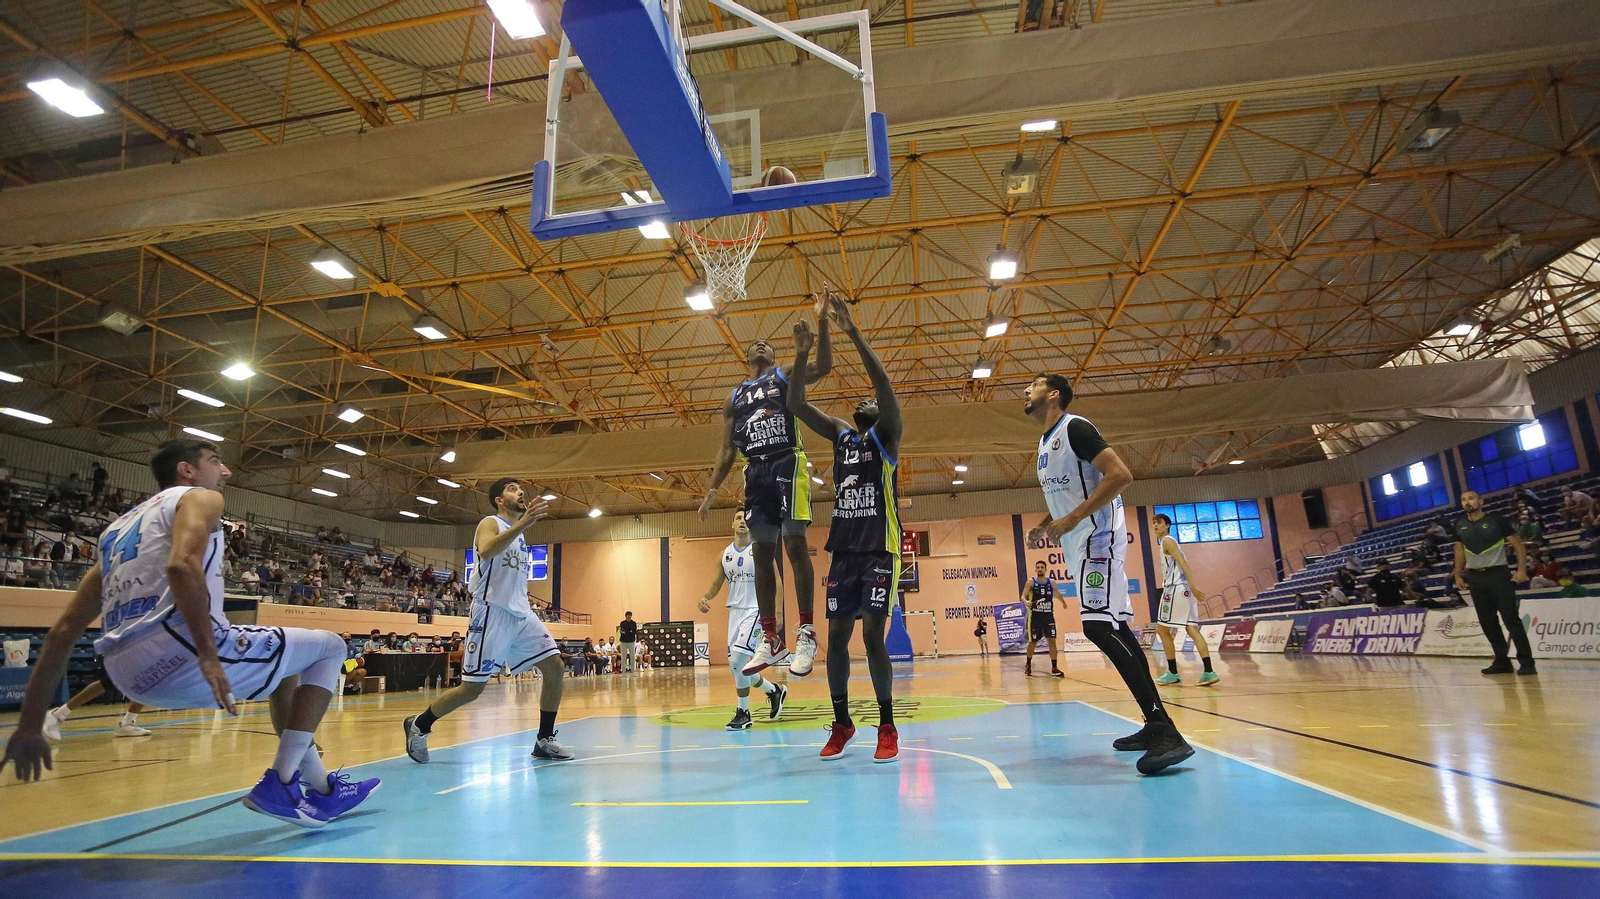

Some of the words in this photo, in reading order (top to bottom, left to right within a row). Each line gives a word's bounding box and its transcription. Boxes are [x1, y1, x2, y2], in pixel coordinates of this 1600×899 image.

[746, 388, 765, 405] 14
[753, 416, 786, 431] ENER
[843, 448, 860, 465] 12
[845, 486, 875, 500] ENER
[100, 514, 142, 579] 14
[942, 566, 970, 579] DELEGACIÓN
[971, 566, 998, 579] MUNICIPAL
[870, 587, 887, 602] 12
[945, 606, 970, 619] DEPORTES
[1312, 637, 1363, 653] ENERGY
[1363, 636, 1420, 653] DRINK
[1538, 642, 1575, 654] Campo
[1579, 643, 1593, 653] de
